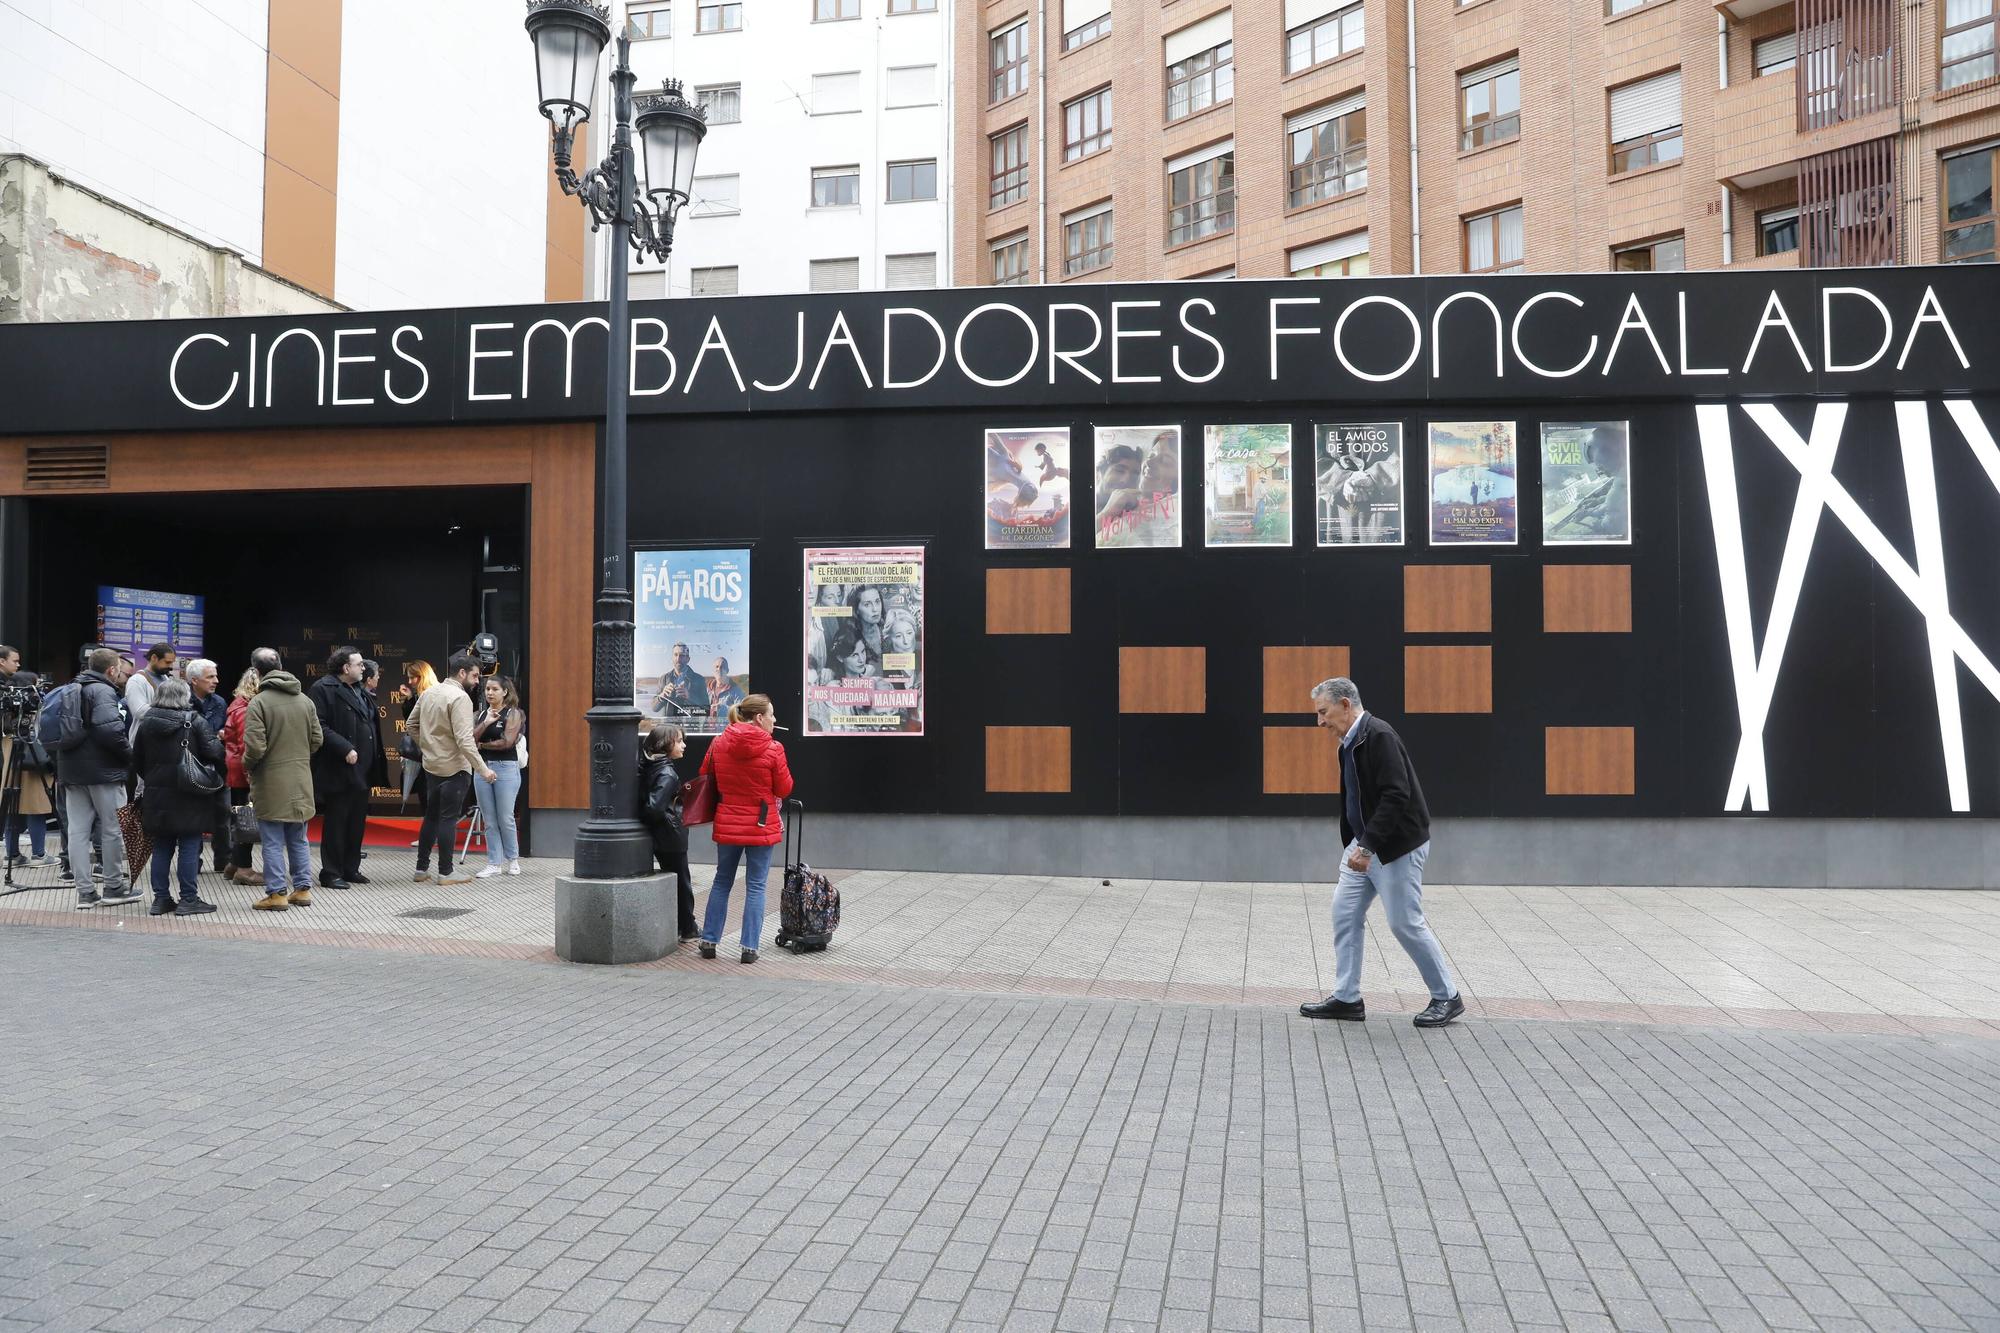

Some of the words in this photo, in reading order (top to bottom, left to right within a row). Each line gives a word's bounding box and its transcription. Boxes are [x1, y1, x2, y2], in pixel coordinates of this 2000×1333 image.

[169, 325, 430, 411] CINES
[468, 297, 1226, 401] EMBAJADORES
[1269, 285, 1974, 384] FONCALADA
[1329, 431, 1342, 441] EL
[1345, 430, 1387, 441] AMIGO
[1328, 443, 1343, 453] DE
[1346, 442, 1389, 453] TODOS
[1548, 442, 1581, 453] CIVIL
[1548, 453, 1582, 465] WAR
[1001, 526, 1054, 535] GUARDIANA
[818, 567, 826, 575] EL
[860, 565, 887, 575] ITALIANO
[887, 566, 899, 575] DEL
[900, 564, 913, 575] AÑO
[641, 559, 743, 612] PÁJAROS
[843, 678, 873, 689] SIEMPRE
[814, 690, 828, 699] NOS
[834, 691, 870, 703] QUEDARÁ
[874, 690, 915, 707] MAÑANA
